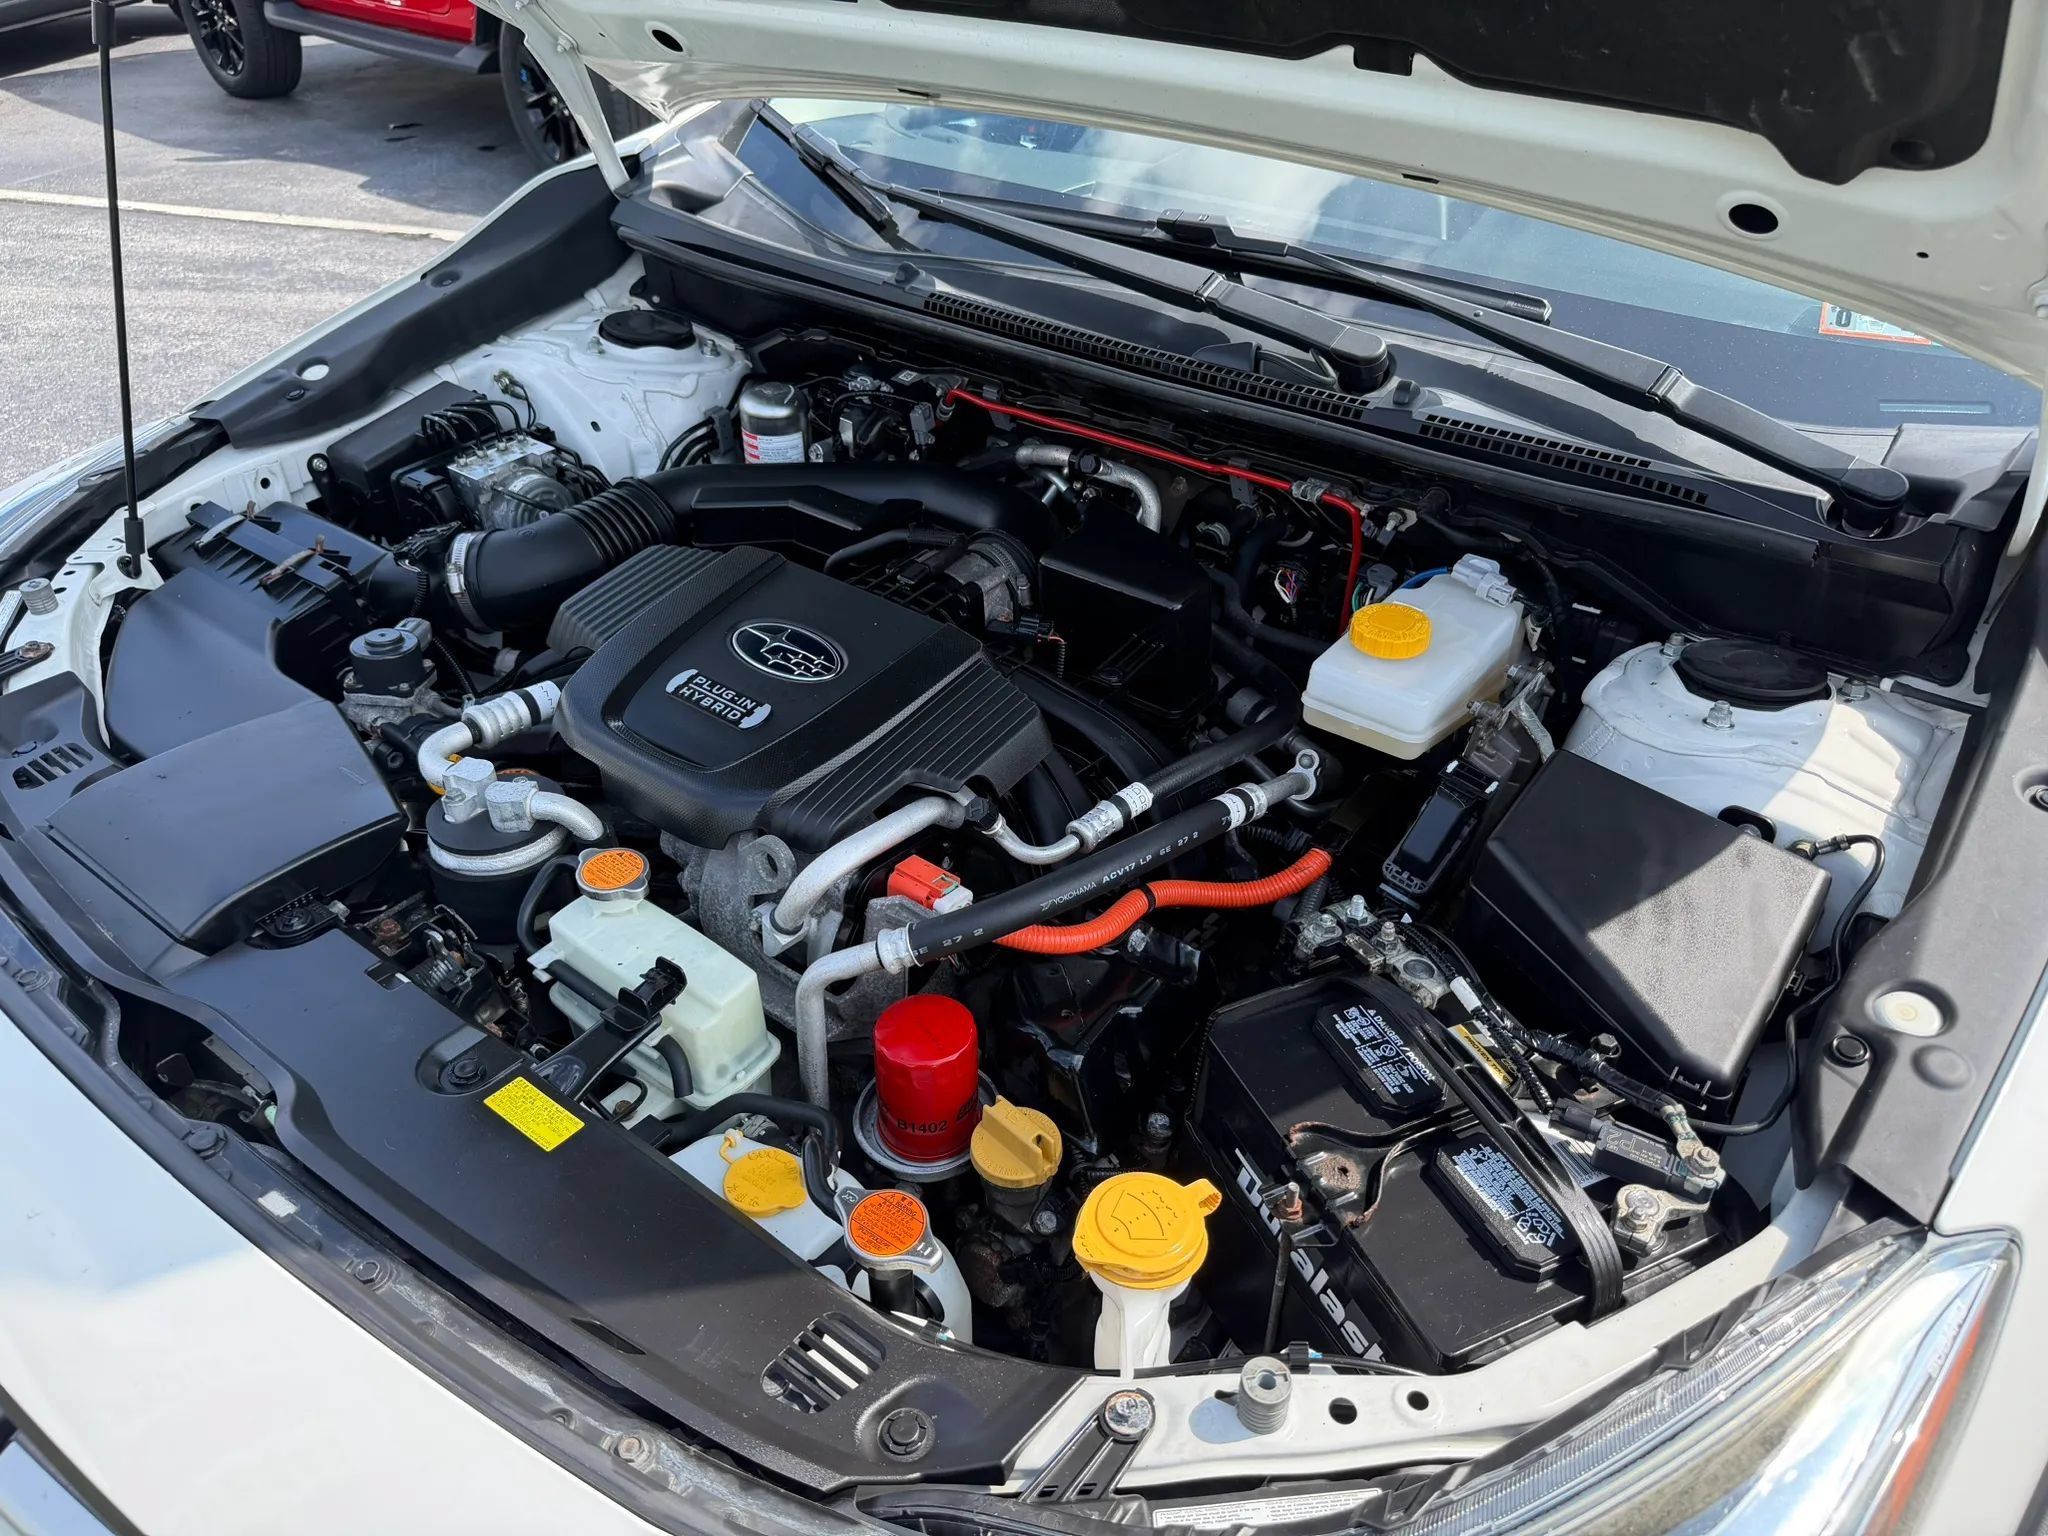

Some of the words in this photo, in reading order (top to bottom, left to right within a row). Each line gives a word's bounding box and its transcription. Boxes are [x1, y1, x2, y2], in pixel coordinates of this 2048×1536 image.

[680, 686, 741, 720] HYBRID
[693, 676, 756, 710] PLUG-IN
[1053, 881, 1097, 906] YOKOHAMA
[1102, 862, 1136, 884] ACV17
[1139, 854, 1153, 866] LP
[1177, 836, 1189, 847] 27
[1373, 1016, 1404, 1045] DANGER
[1405, 1052, 1433, 1078] POISON
[896, 1118, 947, 1133] B1402
[1236, 1148, 1386, 1362] Dualast
